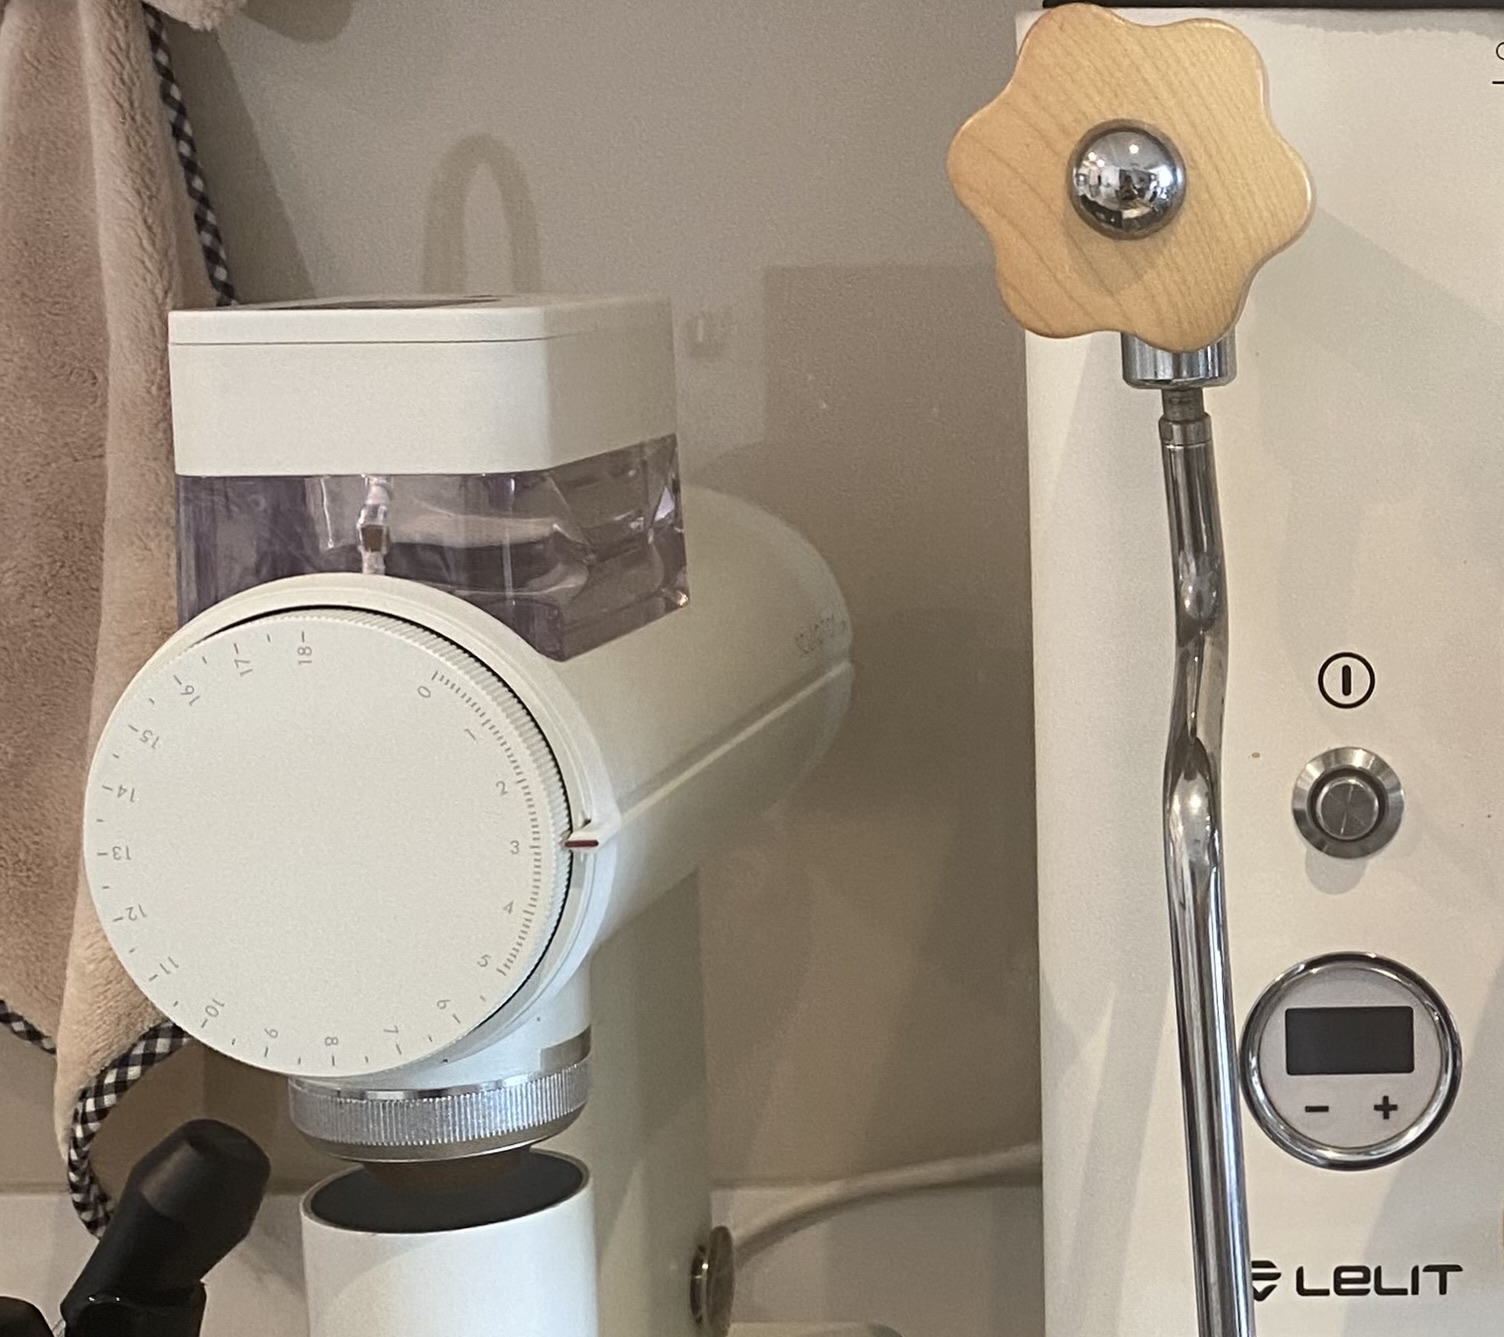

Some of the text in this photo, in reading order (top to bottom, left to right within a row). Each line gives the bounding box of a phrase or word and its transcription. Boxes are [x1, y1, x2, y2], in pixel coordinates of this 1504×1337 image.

[296, 645, 313, 666] 18
[233, 658, 254, 678] 17
[179, 684, 202, 707] 16
[416, 685, 432, 699] 0
[138, 728, 161, 751] 15
[116, 784, 136, 804] 14
[495, 780, 509, 797] 2
[111, 845, 132, 861] 13
[509, 839, 520, 856] 3
[124, 903, 148, 922] 12
[502, 900, 514, 915] 4
[476, 953, 492, 968] 5
[203, 997, 226, 1018] 10
[383, 1024, 400, 1035] 7
[323, 1035, 339, 1047] 8
